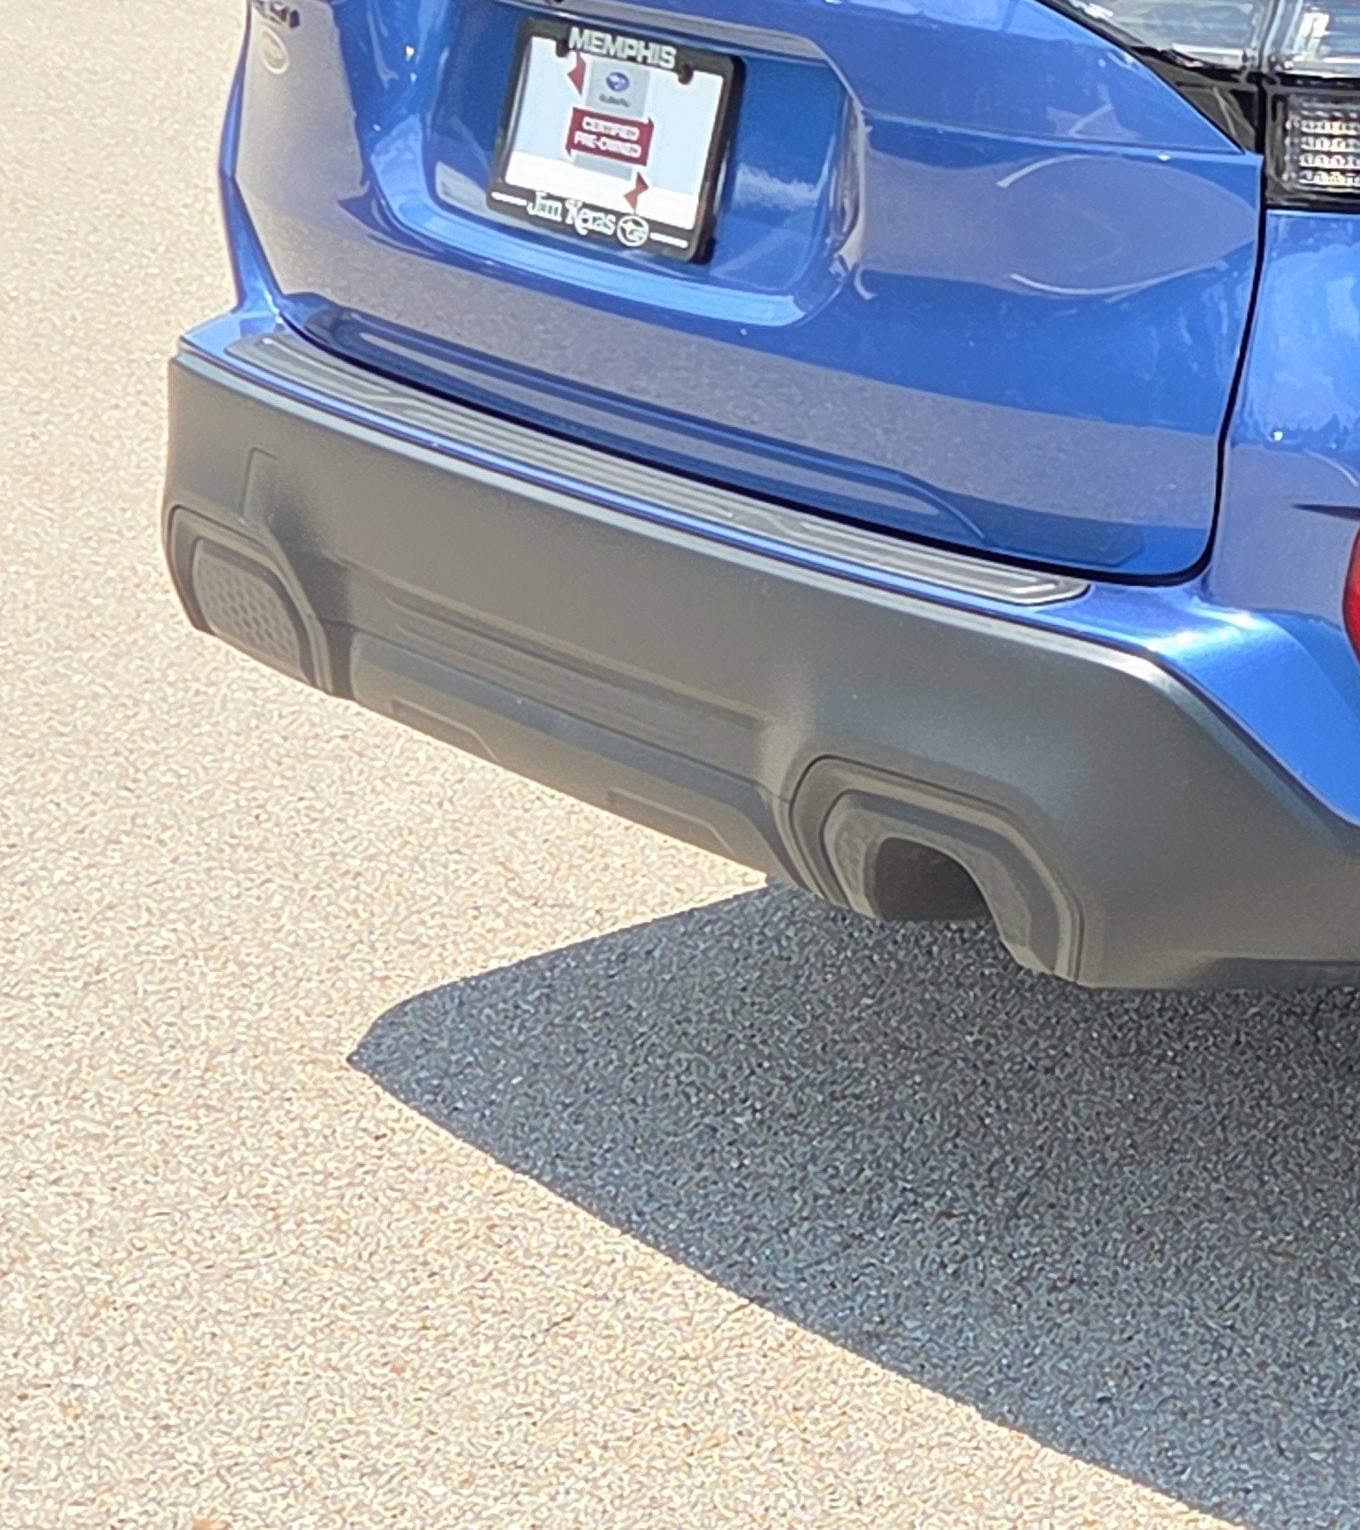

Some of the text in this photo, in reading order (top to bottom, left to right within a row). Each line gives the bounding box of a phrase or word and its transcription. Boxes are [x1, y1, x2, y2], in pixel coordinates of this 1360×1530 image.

[568, 26, 677, 69] MEMPHIS
[526, 191, 617, 235] Jim Keras
